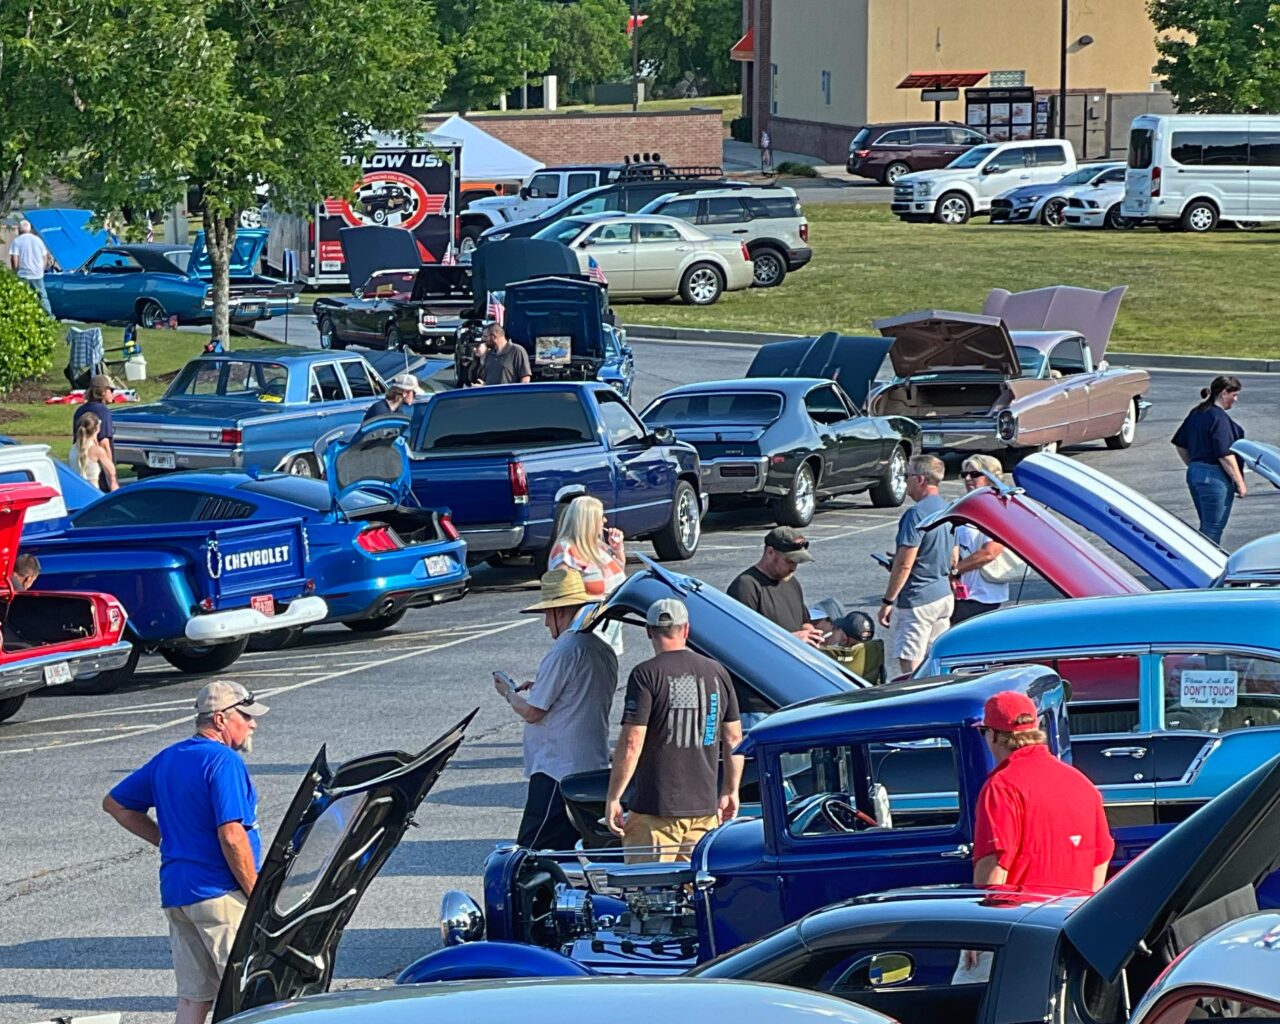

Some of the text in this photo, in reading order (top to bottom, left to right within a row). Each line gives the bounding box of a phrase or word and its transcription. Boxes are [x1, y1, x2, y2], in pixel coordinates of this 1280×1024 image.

[225, 545, 289, 571] CHEVROLET
[1184, 685, 1235, 696] DON'T TOUCH
